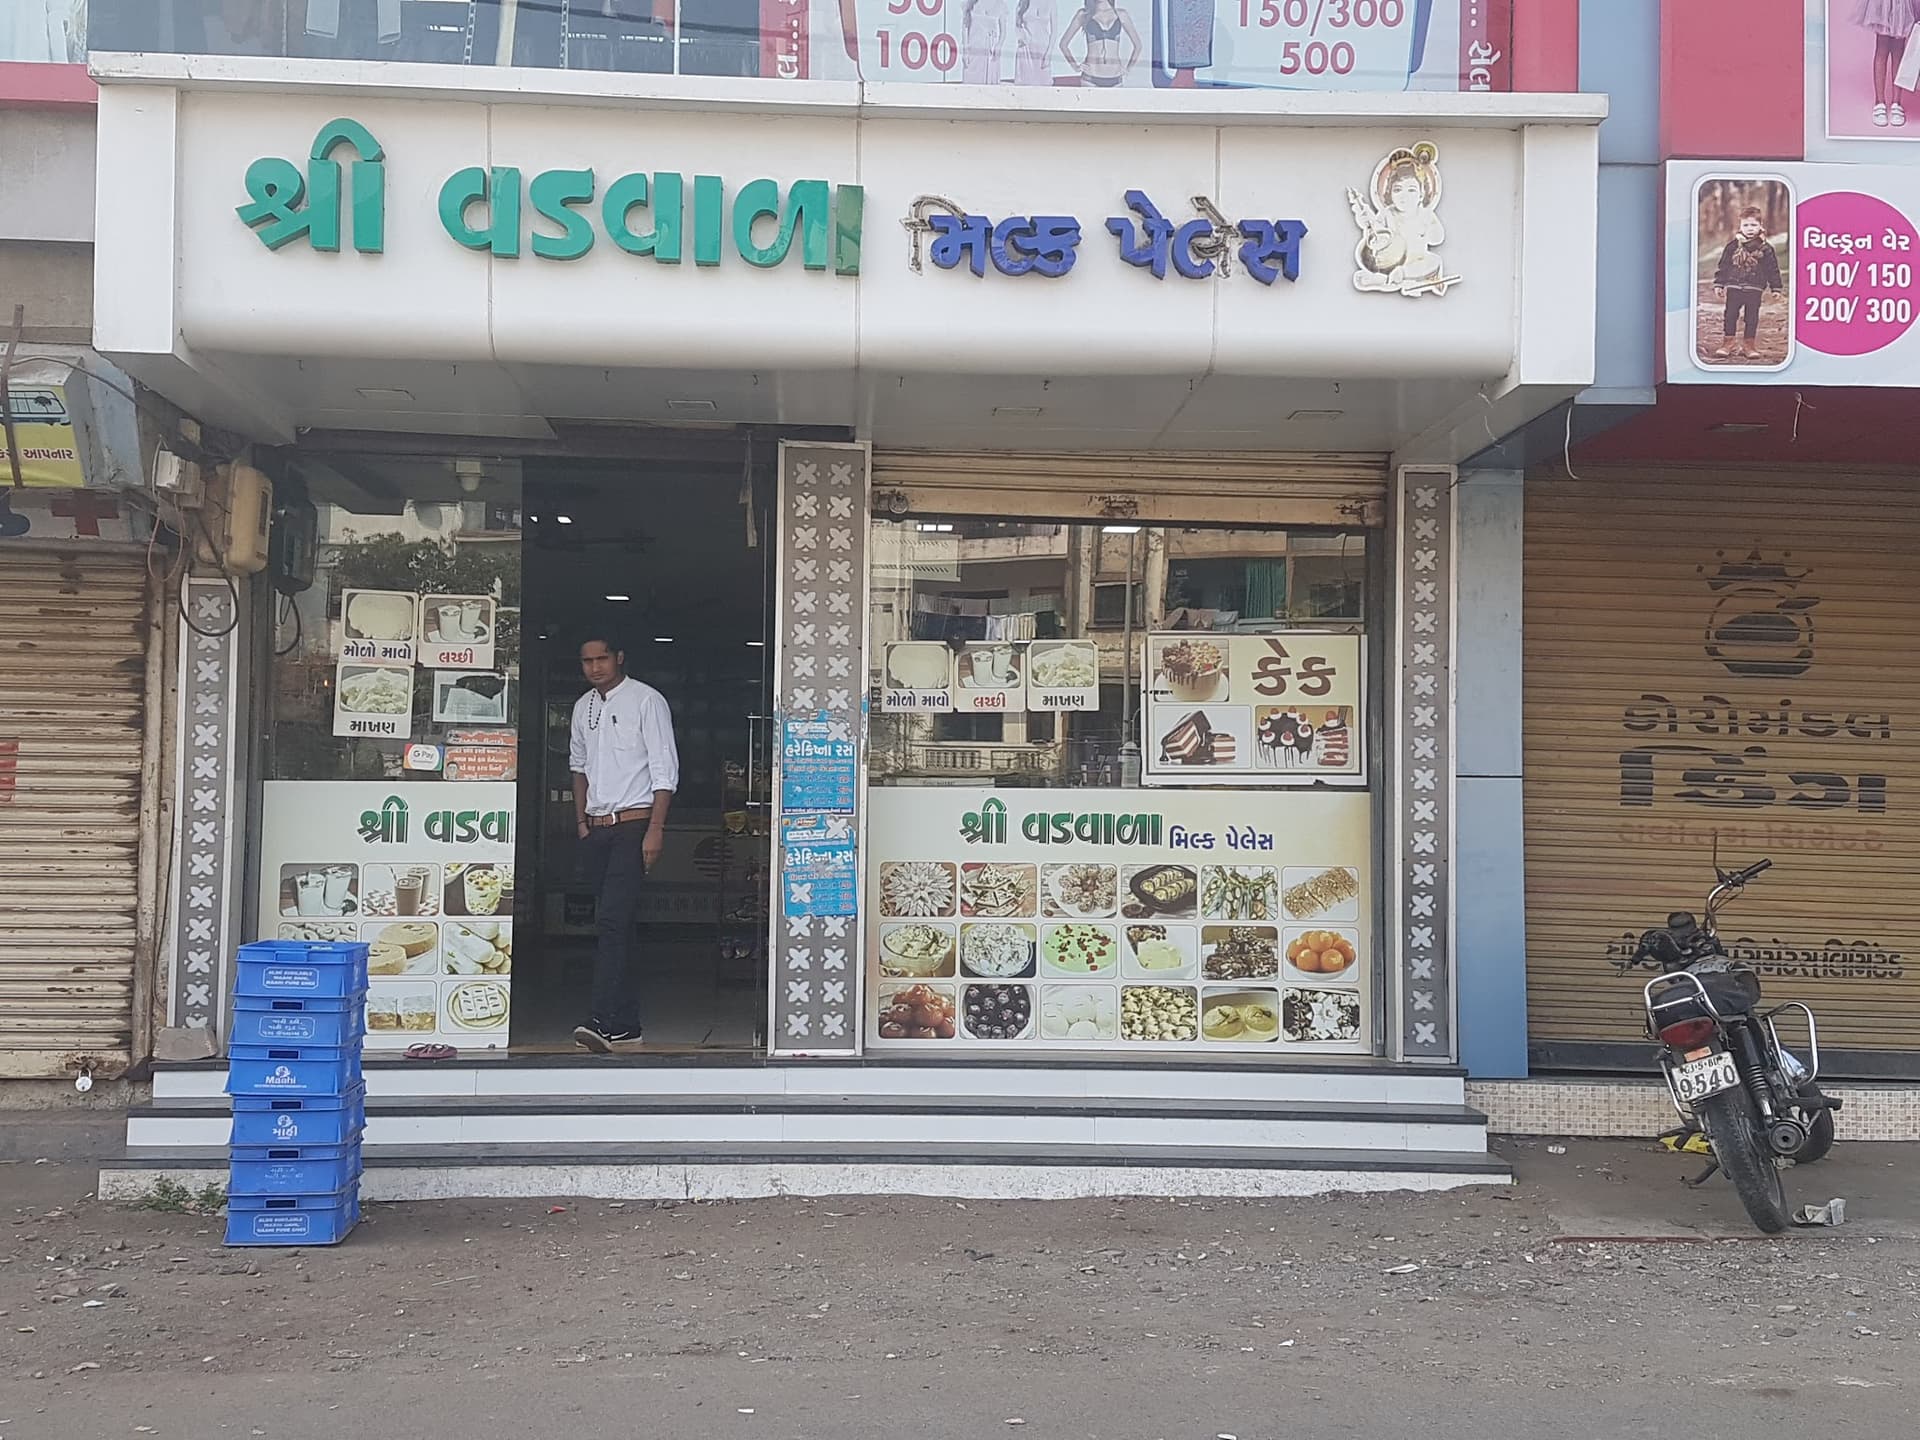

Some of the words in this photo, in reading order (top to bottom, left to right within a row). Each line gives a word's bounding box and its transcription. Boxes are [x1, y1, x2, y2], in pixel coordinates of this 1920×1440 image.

[1239, 0, 1404, 37] 150/300
[875, 30, 957, 71] 100
[1280, 41, 1356, 75] 500
[235, 116, 386, 254] શ્રી
[437, 165, 865, 277] વડવાળા
[1803, 227, 1872, 255] ચિલ્ડ્રન
[1882, 228, 1910, 251] વેર
[1806, 261, 1860, 288] 100/
[1867, 263, 1911, 288] 150
[1805, 296, 1859, 324] 200/
[1866, 298, 1911, 323] 300
[344, 640, 375, 658] મોળો
[382, 643, 412, 659] માવો
[439, 649, 473, 664] લચ્છી
[1251, 638, 1336, 697] કેક
[886, 691, 916, 707] મોળો
[921, 692, 949, 707] માવો
[973, 691, 1006, 708] લચ્છી
[1042, 692, 1085, 707] માખણ
[350, 720, 395, 734] માખણ
[357, 795, 409, 844] શ્રી
[423, 809, 514, 843] વડવ
[959, 797, 1007, 846] શ્રી
[1022, 810, 1164, 847] વડવાળા
[1169, 825, 1216, 850] મિલ્ક
[1225, 826, 1274, 851] પેલેસ
[1678, 1064, 1736, 1099] 9540
